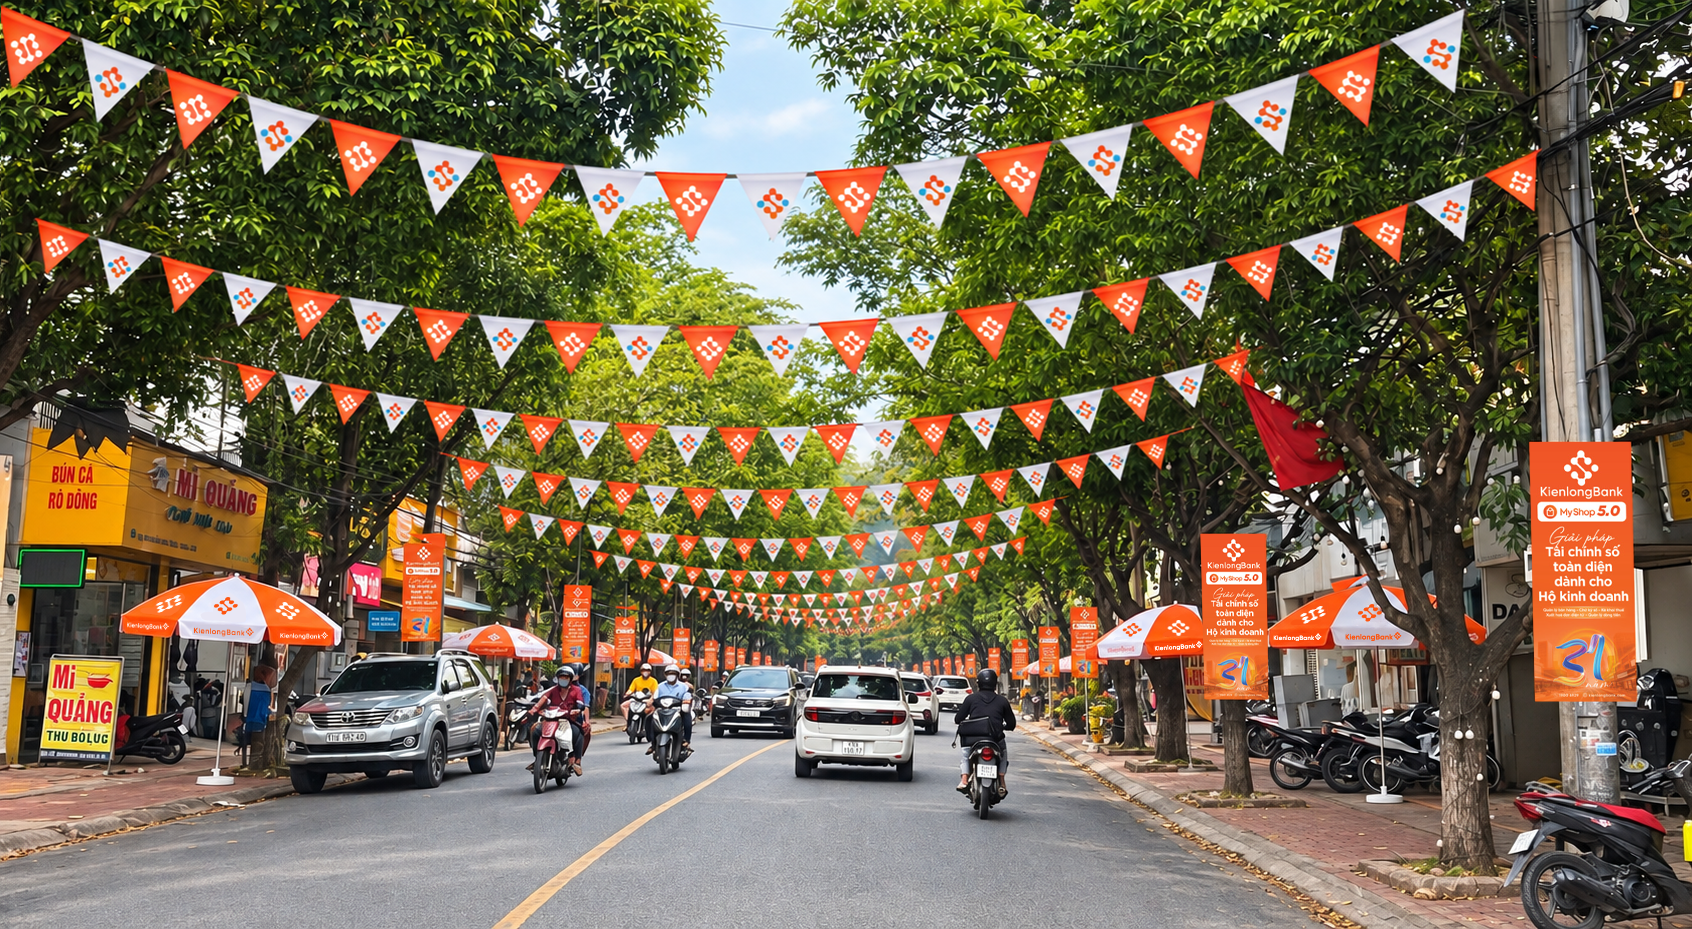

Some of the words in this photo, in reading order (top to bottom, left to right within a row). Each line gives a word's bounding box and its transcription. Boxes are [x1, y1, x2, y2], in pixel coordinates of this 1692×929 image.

[51, 462, 76, 484] BÚN
[203, 478, 258, 516] QUẢNG
[1540, 486, 1623, 500] KienlongBank
[1559, 507, 1596, 518] MyShop
[1596, 505, 1621, 517] 5.0
[1549, 525, 1583, 550] Giải
[1582, 529, 1615, 549] pháp
[1567, 545, 1602, 557] chính
[1605, 544, 1621, 557] số
[1207, 561, 1261, 571] KienlongBank
[1553, 560, 1582, 573] toàn
[1585, 560, 1613, 575] diện
[1219, 575, 1243, 583] MyShop
[1243, 573, 1259, 582] 5.0
[1554, 575, 1586, 588] dành
[1588, 575, 1613, 588] cho
[1248, 598, 1259, 608] số
[1538, 590, 1556, 605] Hộ
[1559, 590, 1586, 602] kinh
[1589, 590, 1629, 602] doanh
[1215, 609, 1235, 617] toàn
[1236, 608, 1254, 618] diện
[126, 621, 163, 630] KienlongBank
[1216, 618, 1237, 627] dành
[1238, 618, 1254, 627] cho
[193, 627, 246, 637] KienlongBank
[279, 632, 321, 640] KienlongBank
[1206, 627, 1218, 638] Hộ
[1219, 628, 1237, 636] kinh
[1238, 628, 1264, 636] doanh
[1273, 634, 1315, 642] KienlongBank
[1344, 633, 1394, 642] KienlongBank
[1552, 633, 1605, 687] 31
[1215, 656, 1249, 690] 31
[47, 692, 113, 724] QUẢNG
[46, 730, 69, 742] THU
